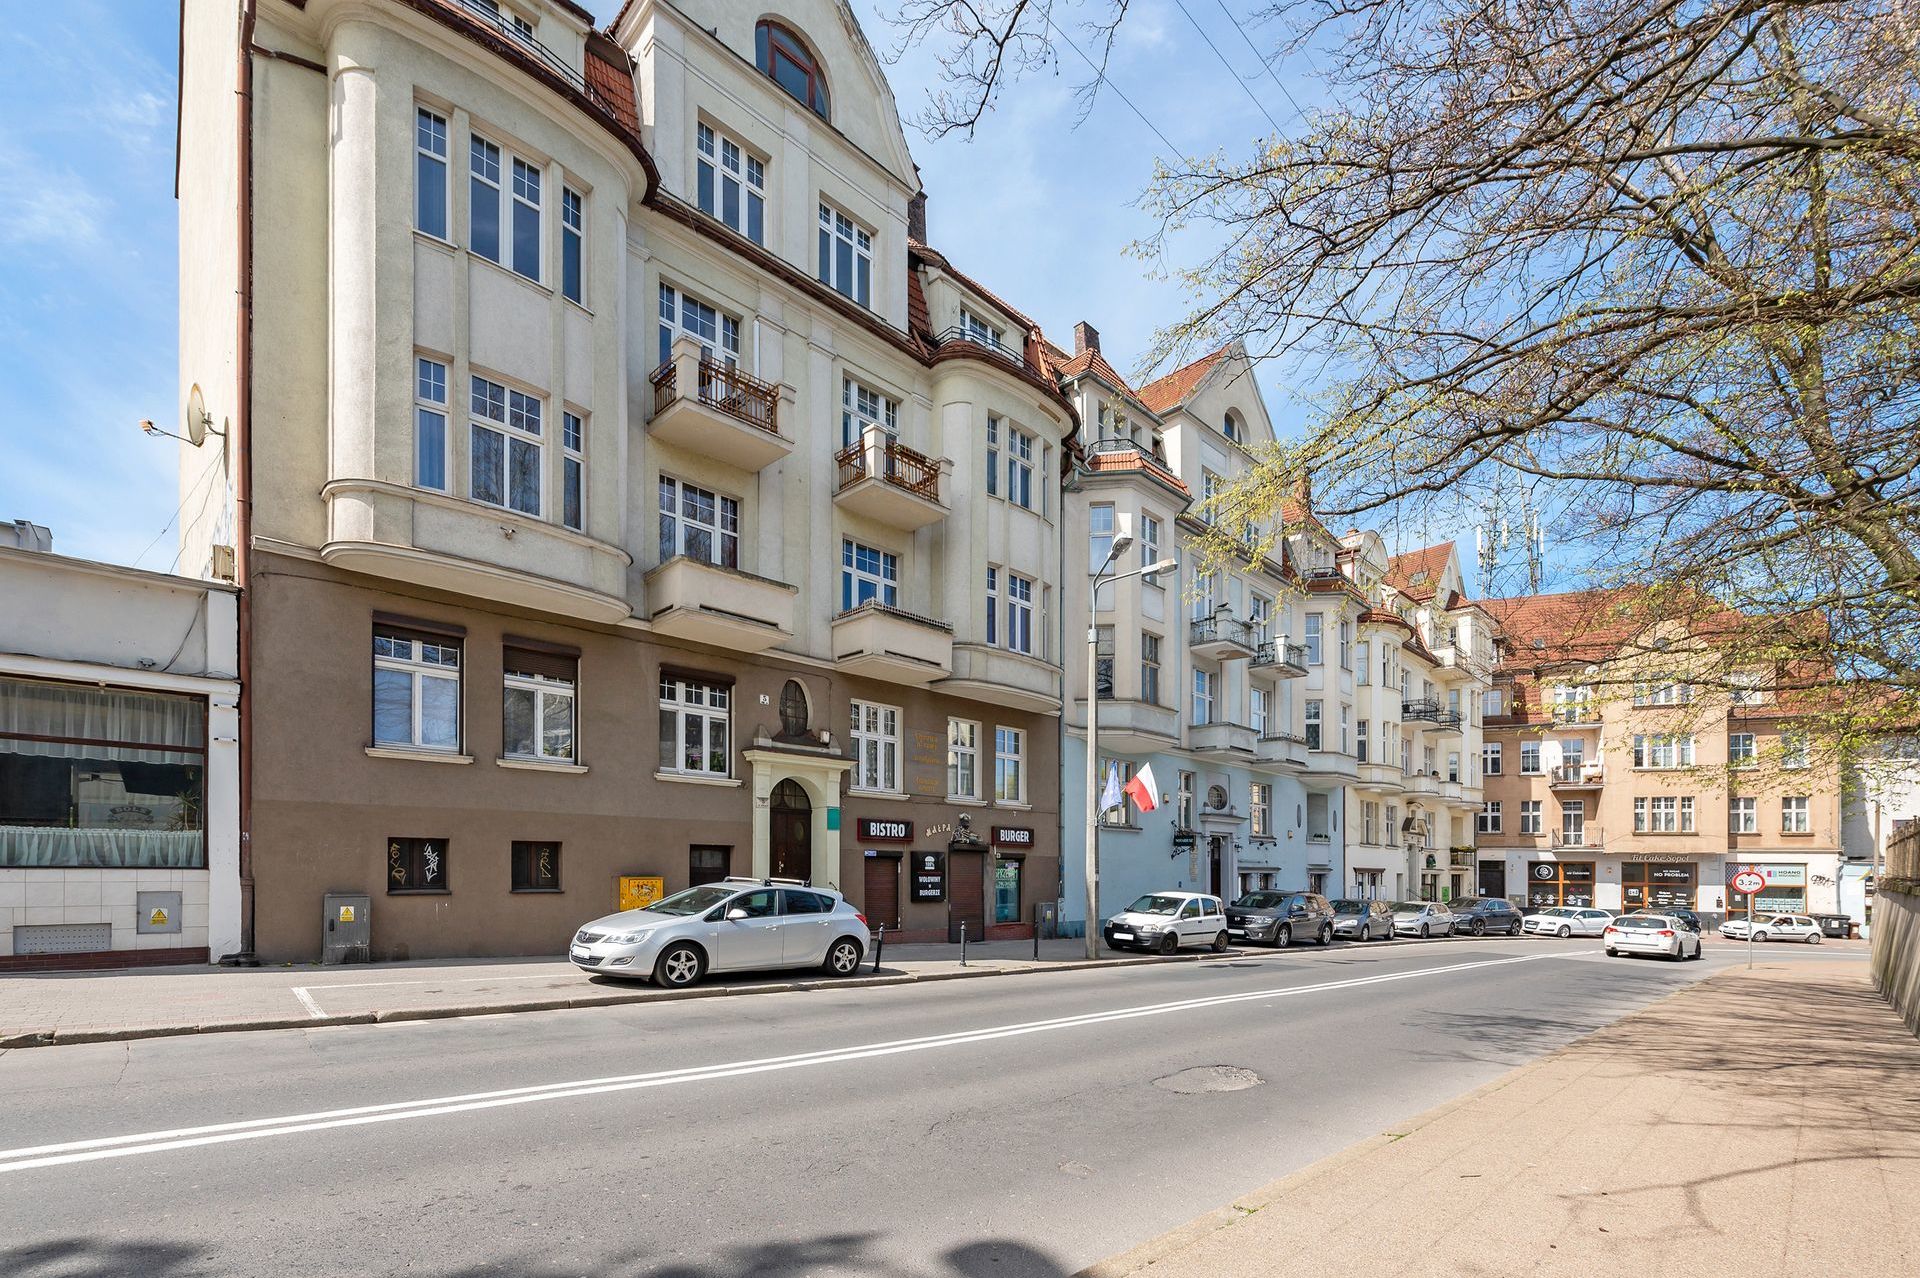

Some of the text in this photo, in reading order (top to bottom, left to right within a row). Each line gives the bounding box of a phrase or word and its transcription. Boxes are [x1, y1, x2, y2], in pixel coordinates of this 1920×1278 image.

[870, 822, 905, 837] BISTRO
[925, 823, 951, 837] MAŁPA
[1000, 829, 1030, 843] BURGER
[1643, 854, 1664, 862] Cake
[1666, 855, 1690, 863] Sopot
